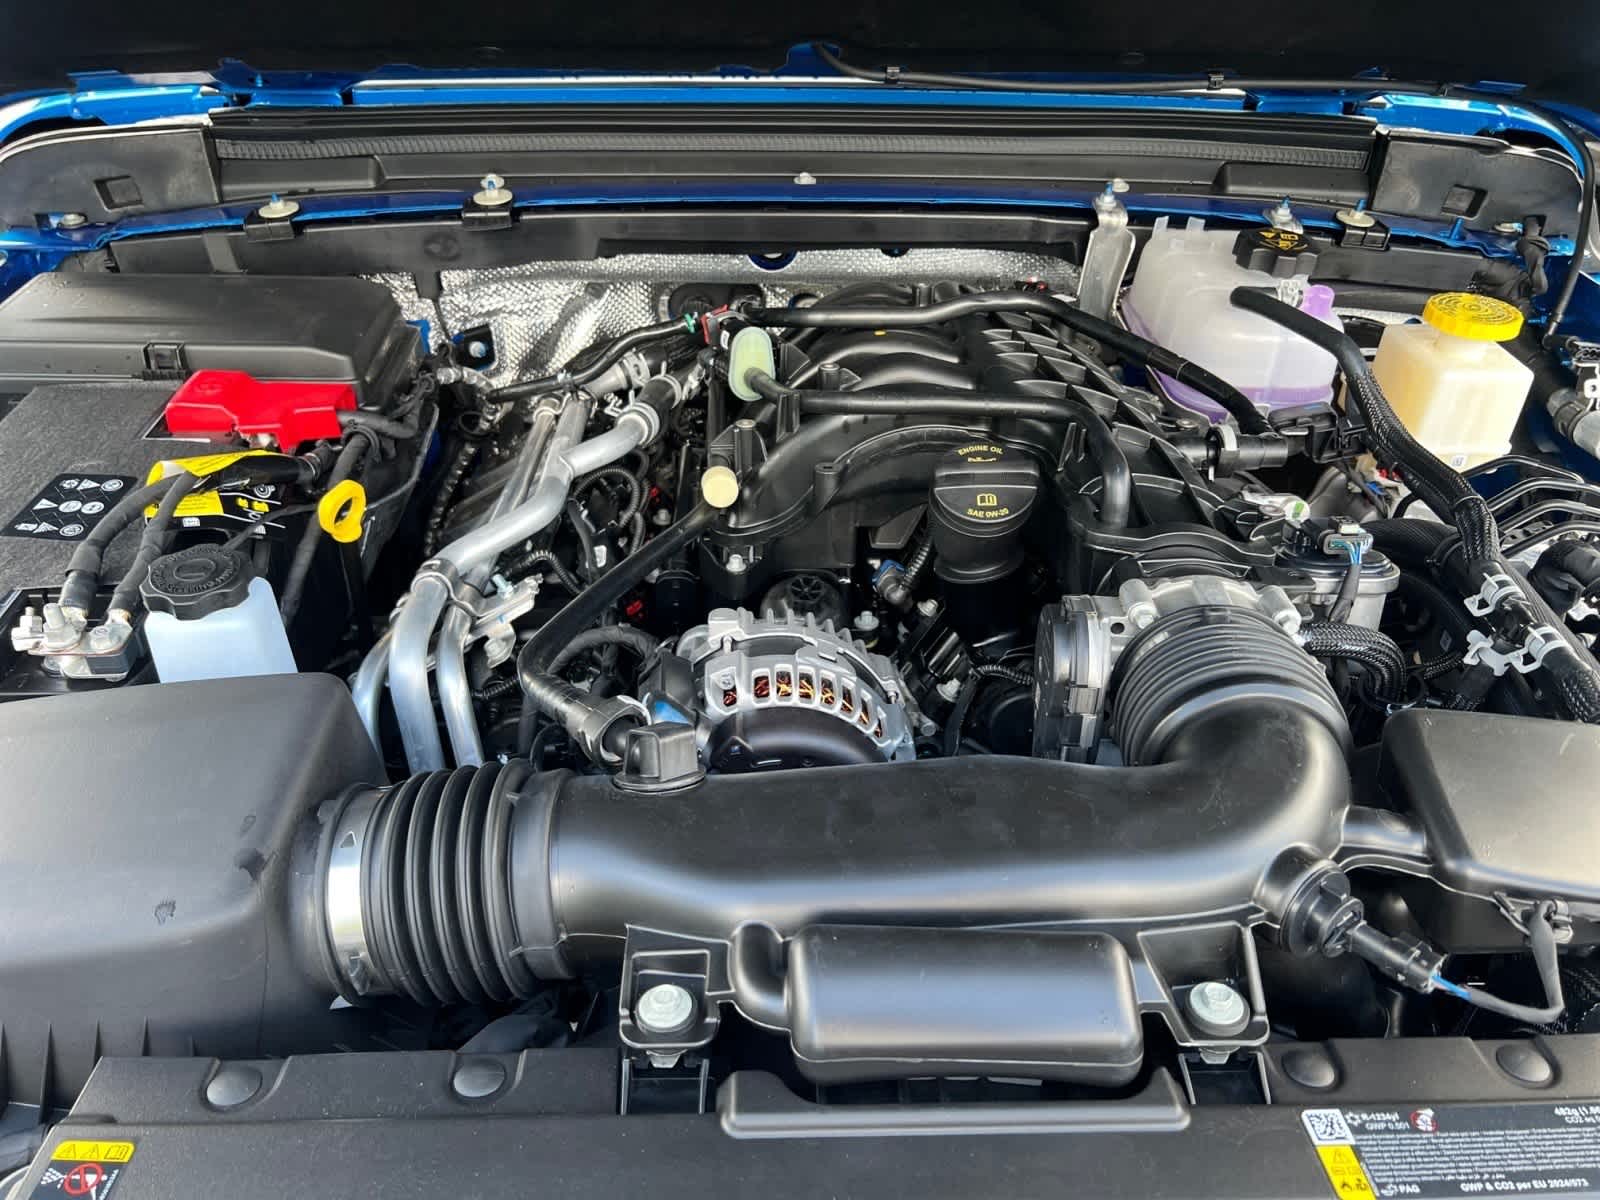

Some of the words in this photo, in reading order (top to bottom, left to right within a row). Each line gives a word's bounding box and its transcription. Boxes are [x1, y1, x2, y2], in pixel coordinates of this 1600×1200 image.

[958, 445, 989, 455] ENGINE
[990, 446, 1003, 454] OIL
[967, 509, 983, 518] SAE
